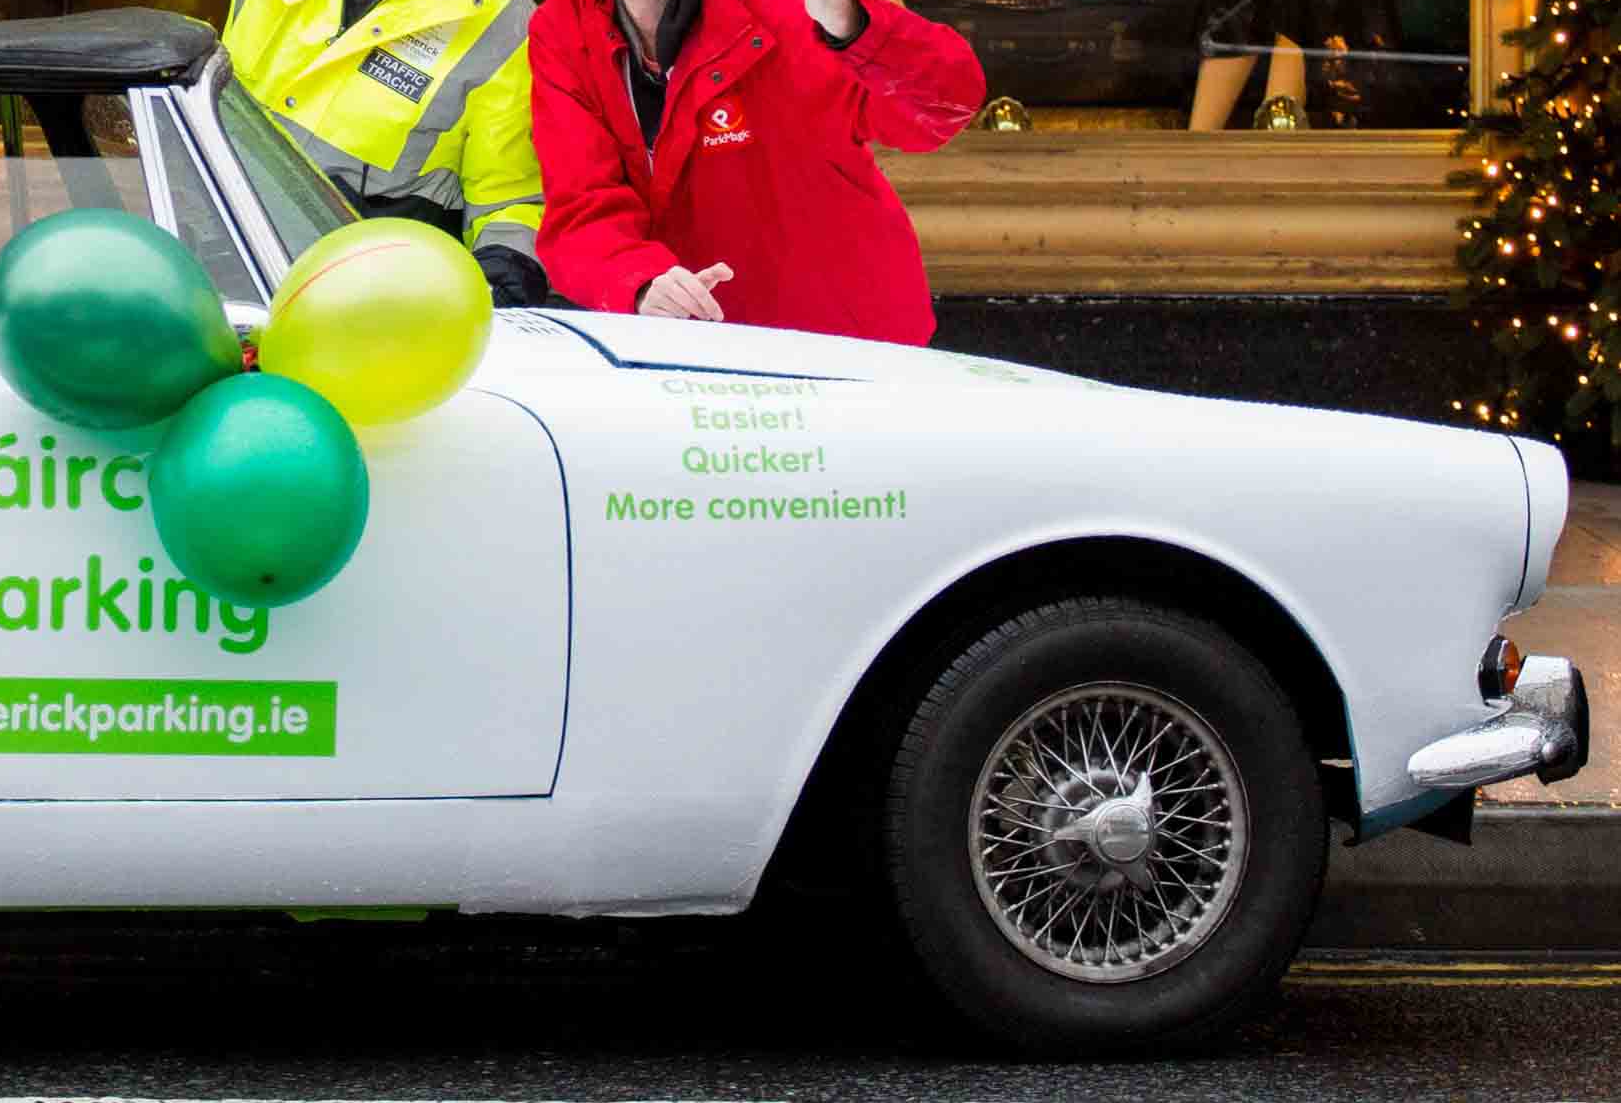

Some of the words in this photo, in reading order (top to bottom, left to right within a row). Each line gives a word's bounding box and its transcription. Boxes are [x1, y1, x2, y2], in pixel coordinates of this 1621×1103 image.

[368, 62, 419, 96] TRACHT
[374, 53, 427, 86] TRAFFIC
[691, 404, 805, 431] Easier!
[682, 445, 826, 474] Quicker!
[605, 491, 695, 521] More
[707, 489, 907, 520] convenient!
